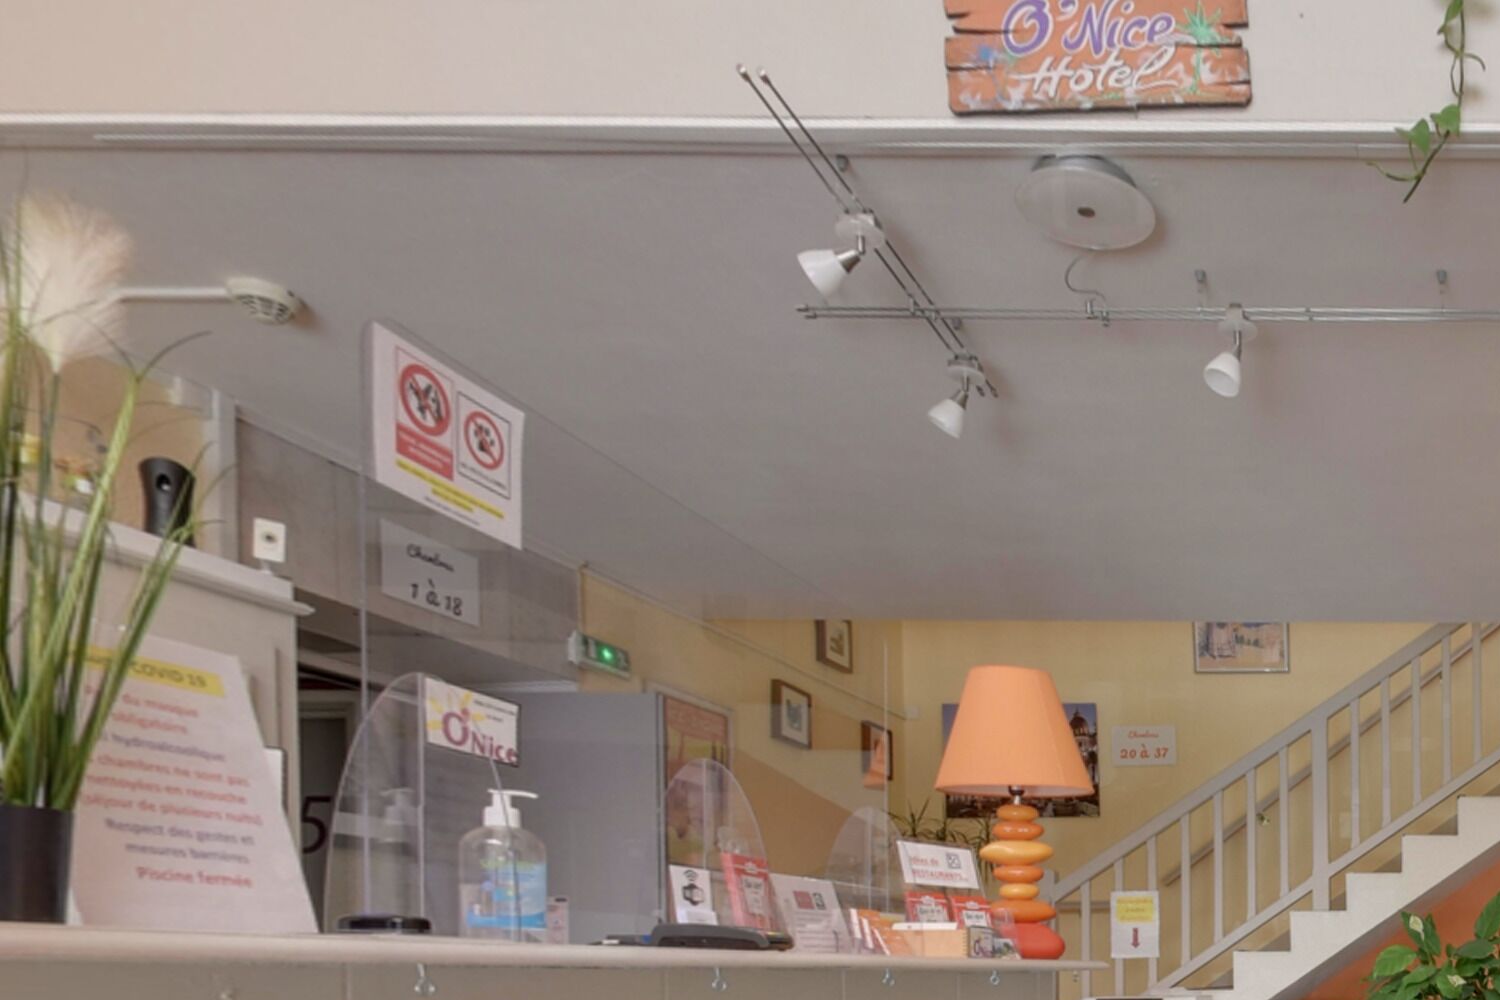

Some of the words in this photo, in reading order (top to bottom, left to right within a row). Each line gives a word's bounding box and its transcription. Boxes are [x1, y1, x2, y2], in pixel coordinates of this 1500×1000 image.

[1001, 0, 1176, 57] O'Nice
[1009, 45, 1179, 99] Hotel
[411, 583, 419, 599] 1
[445, 595, 463, 617] 18
[1119, 748, 1137, 759] 20
[1153, 747, 1169, 759] 37
